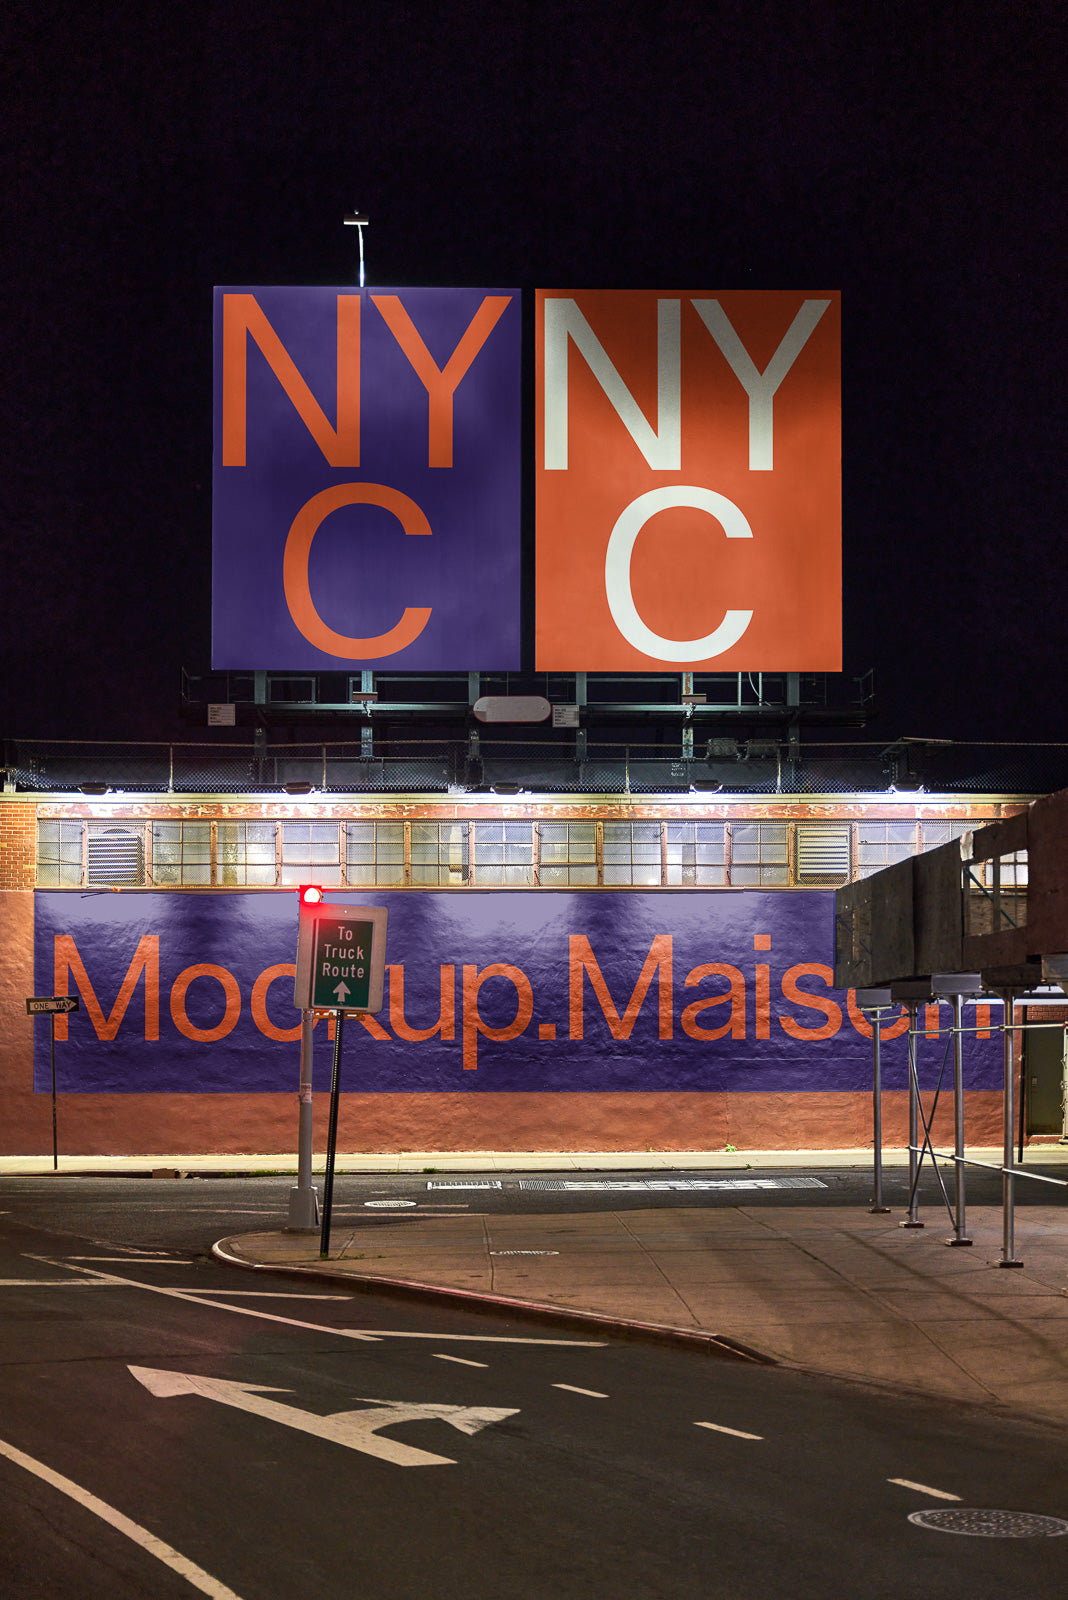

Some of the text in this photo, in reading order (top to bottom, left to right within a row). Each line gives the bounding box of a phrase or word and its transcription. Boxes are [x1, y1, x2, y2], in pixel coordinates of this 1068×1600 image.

[222, 294, 513, 468] NY
[544, 298, 831, 471] NY
[283, 482, 433, 660] C
[605, 485, 754, 663] C
[322, 962, 365, 979] Route
[324, 943, 365, 960] Truck
[338, 926, 353, 941] To
[33, 1001, 72, 1010] ONE WAY
